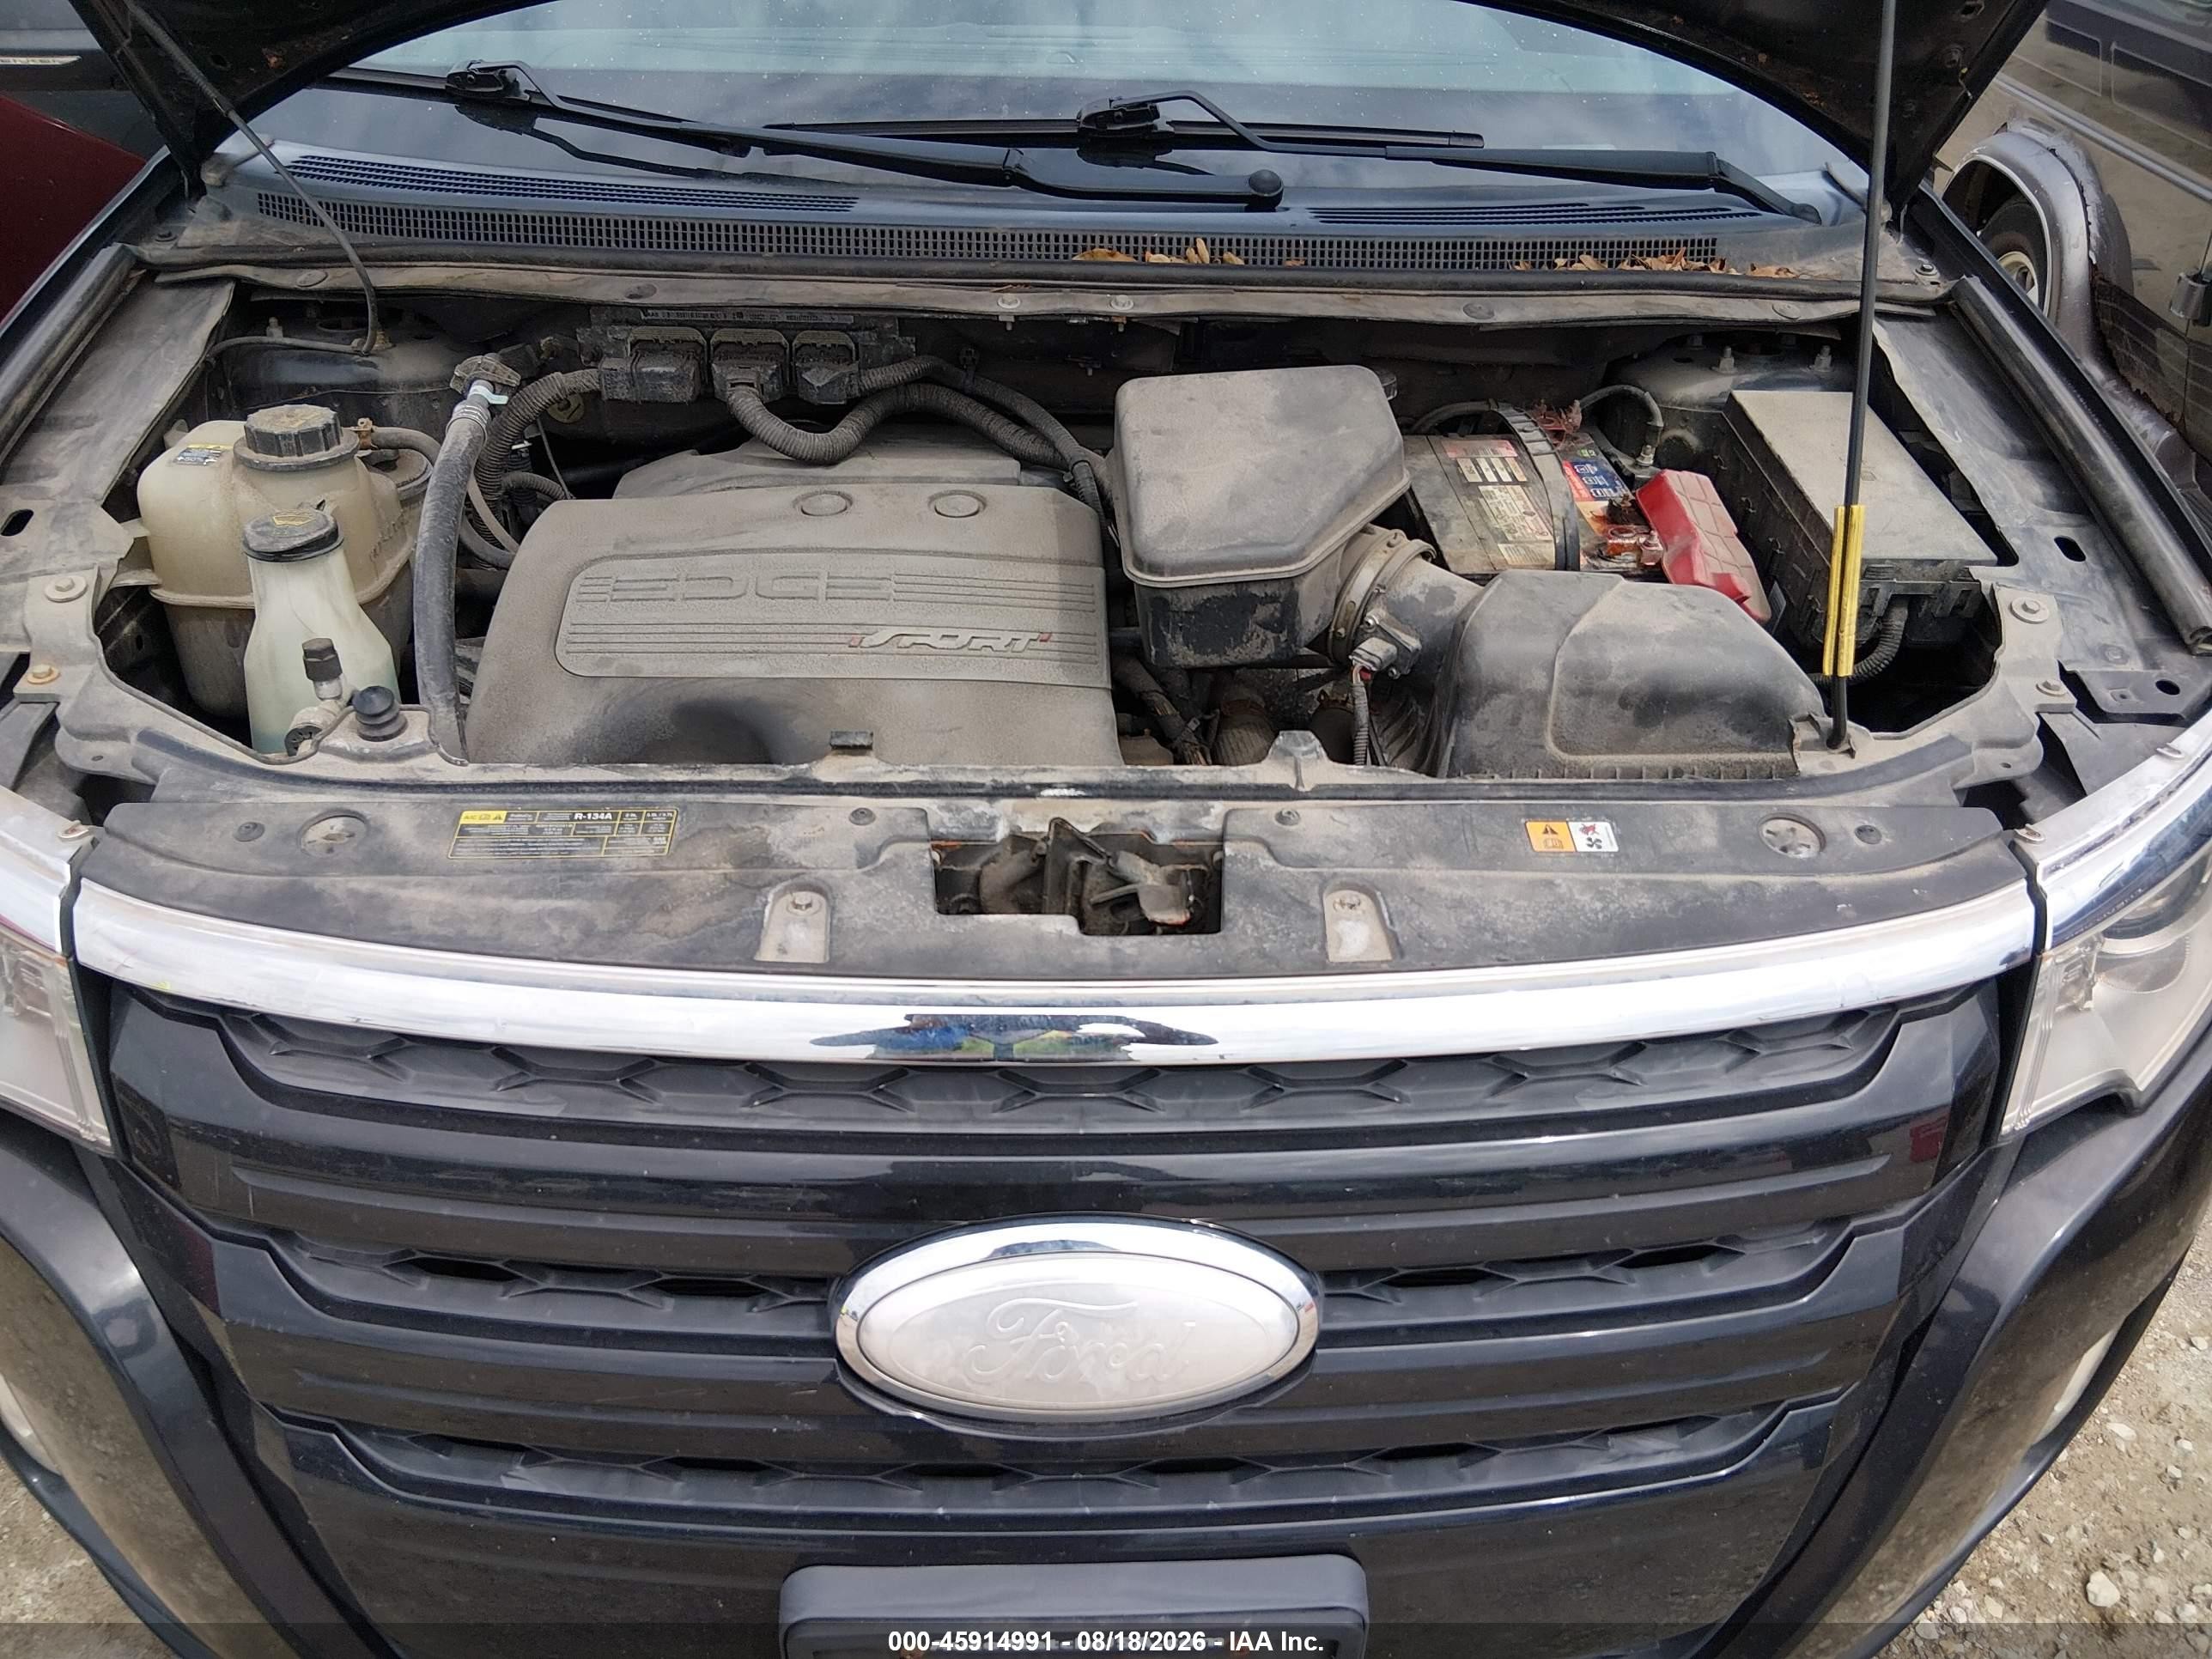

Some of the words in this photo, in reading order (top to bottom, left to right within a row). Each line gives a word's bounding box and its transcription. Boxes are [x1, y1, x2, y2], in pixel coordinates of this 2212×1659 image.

[611, 574, 893, 602] EDGE
[859, 628, 1041, 653] SPORT
[962, 1297, 1196, 1383] Ford
